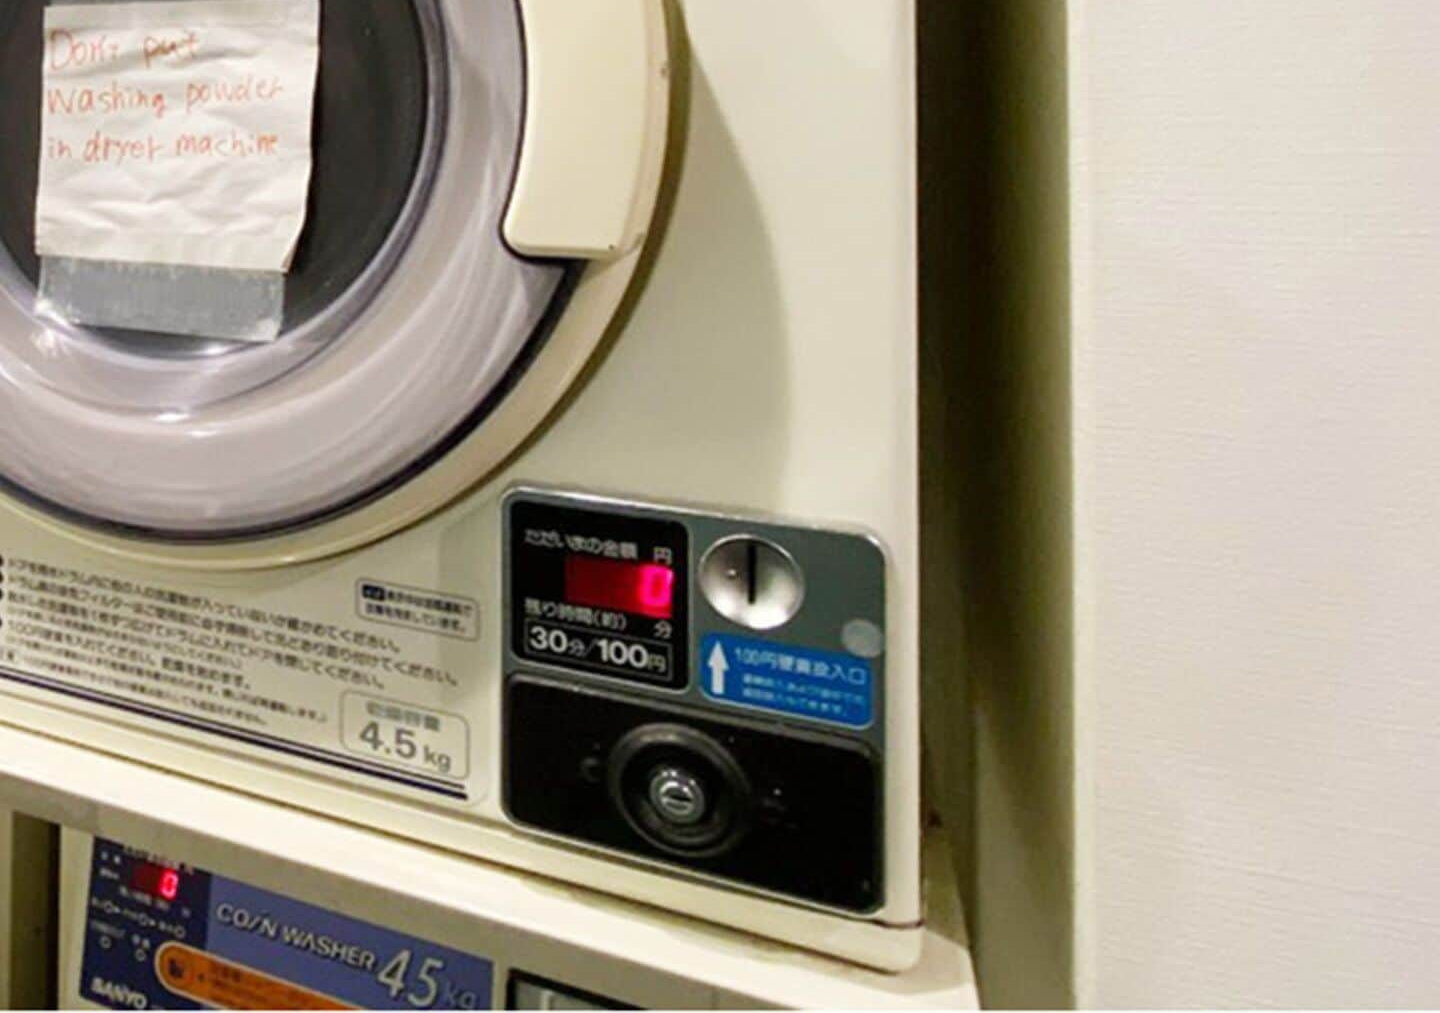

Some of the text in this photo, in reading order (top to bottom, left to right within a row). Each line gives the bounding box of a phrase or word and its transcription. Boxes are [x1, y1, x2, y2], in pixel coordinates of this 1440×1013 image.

[143, 30, 198, 68] put
[186, 73, 284, 115] powder
[48, 136, 72, 159] in
[84, 129, 163, 166] dryer
[639, 564, 674, 607] 0
[359, 720, 451, 773] 4.5 kg
[282, 925, 375, 970] WASHER
